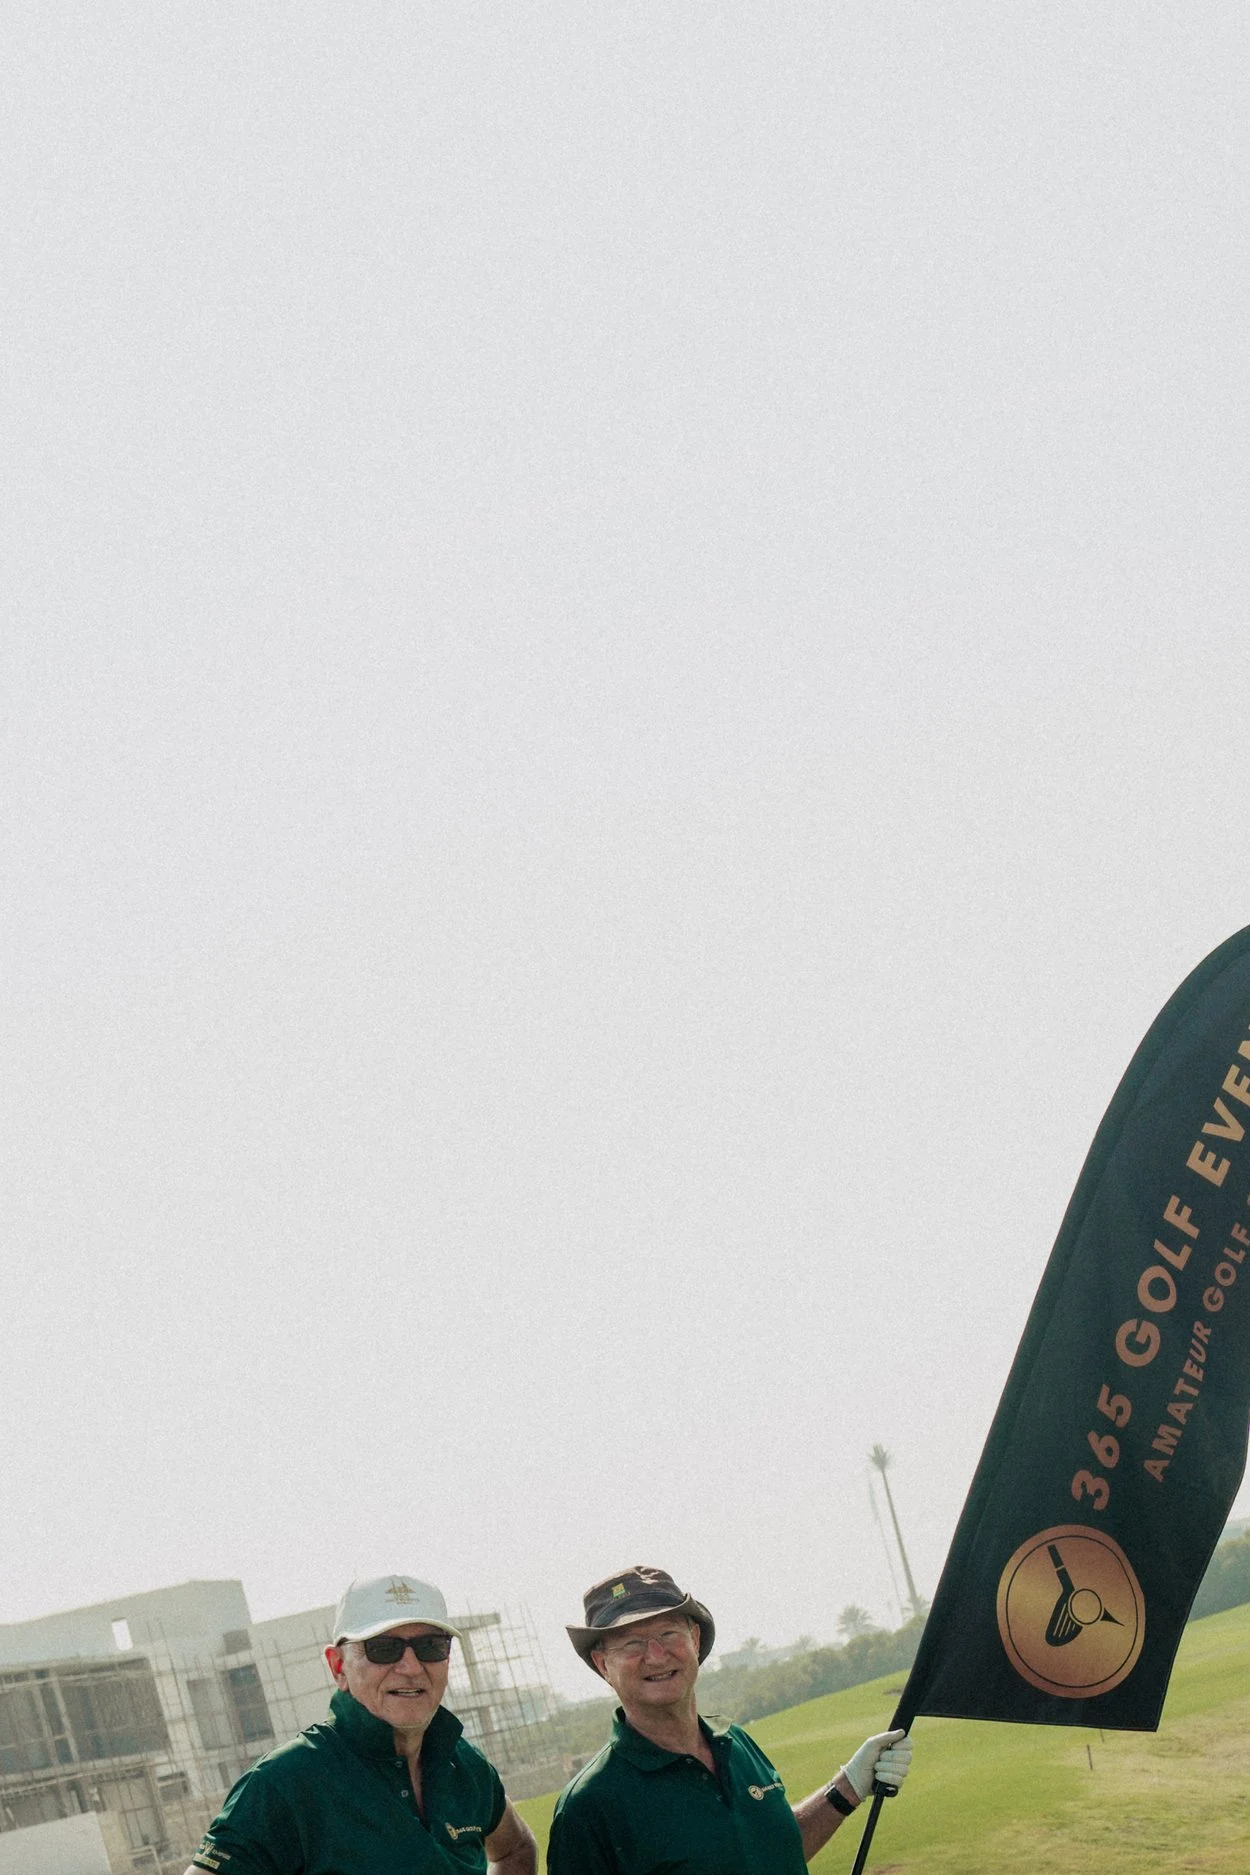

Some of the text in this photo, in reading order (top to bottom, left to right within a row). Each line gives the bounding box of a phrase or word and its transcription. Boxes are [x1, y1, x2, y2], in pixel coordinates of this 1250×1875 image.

[1071, 1384, 1134, 1511] 365
[1114, 1194, 1201, 1368] GOLF
[1143, 1320, 1212, 1482] AMATEUR
